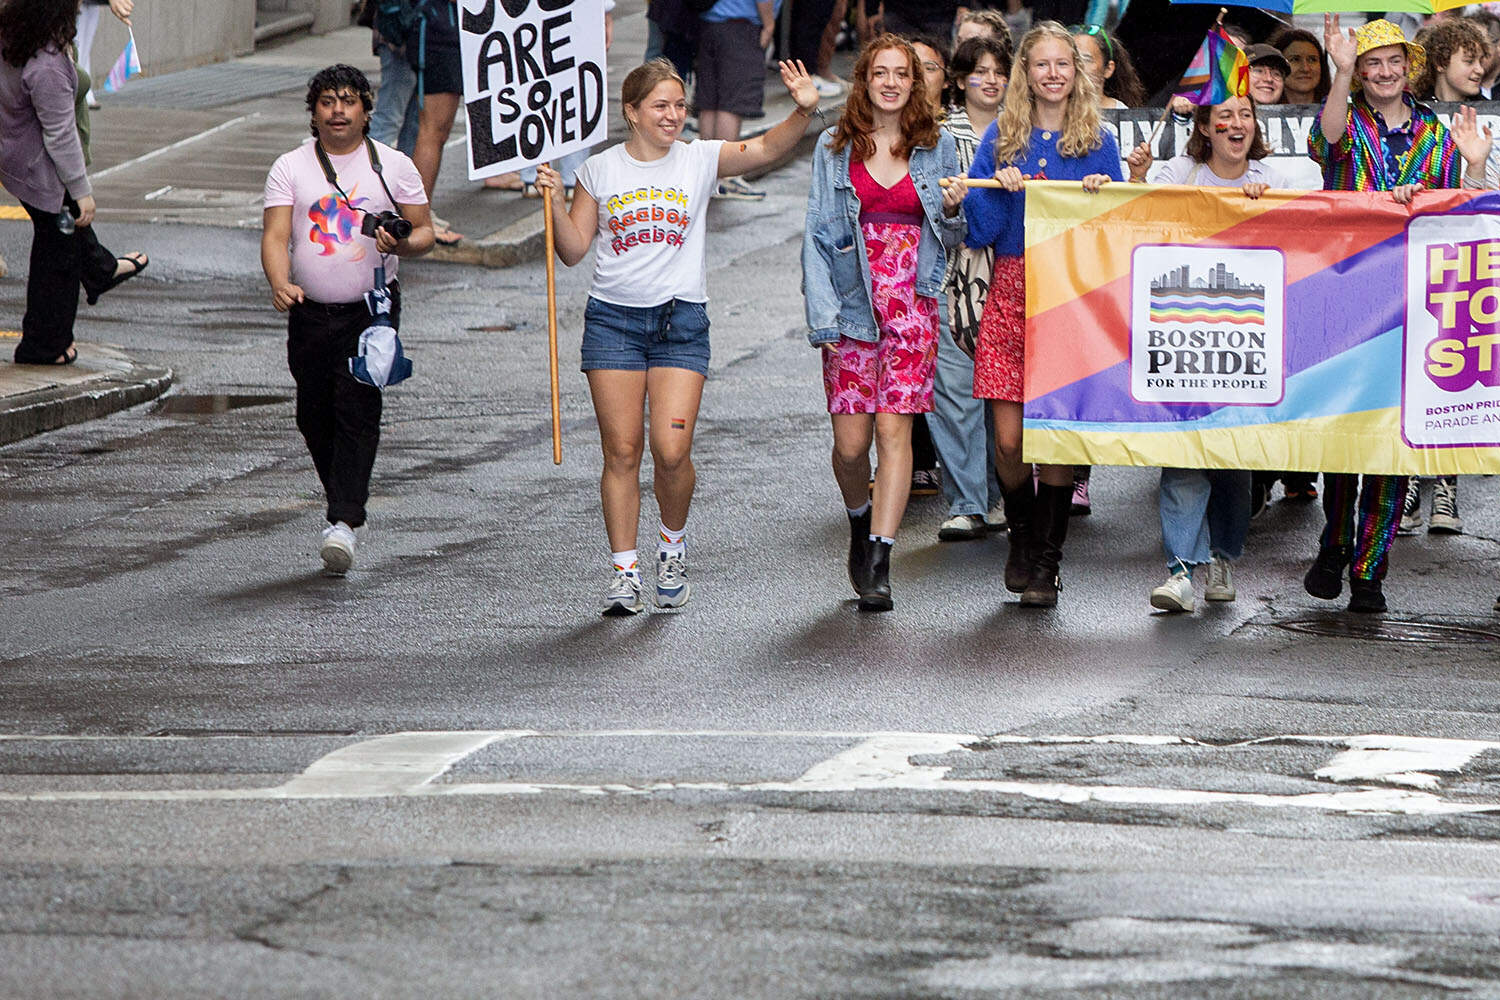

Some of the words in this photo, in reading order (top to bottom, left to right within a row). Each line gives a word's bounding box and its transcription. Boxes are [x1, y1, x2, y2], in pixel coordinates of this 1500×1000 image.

[477, 11, 575, 93] ARE
[465, 61, 603, 170] LOVED
[497, 80, 552, 124] SO
[608, 186, 689, 215] Reebok
[608, 204, 691, 236] Reebok
[610, 225, 687, 256] Reebok
[1147, 330, 1266, 349] BOSTON
[1147, 350, 1267, 376] PRIDE
[1147, 378, 1175, 388] FOR
[1179, 379, 1208, 388] THE
[1213, 379, 1267, 390] PEOPLE
[1426, 402, 1474, 416] BOSTON
[1425, 417, 1478, 431] PARADE
